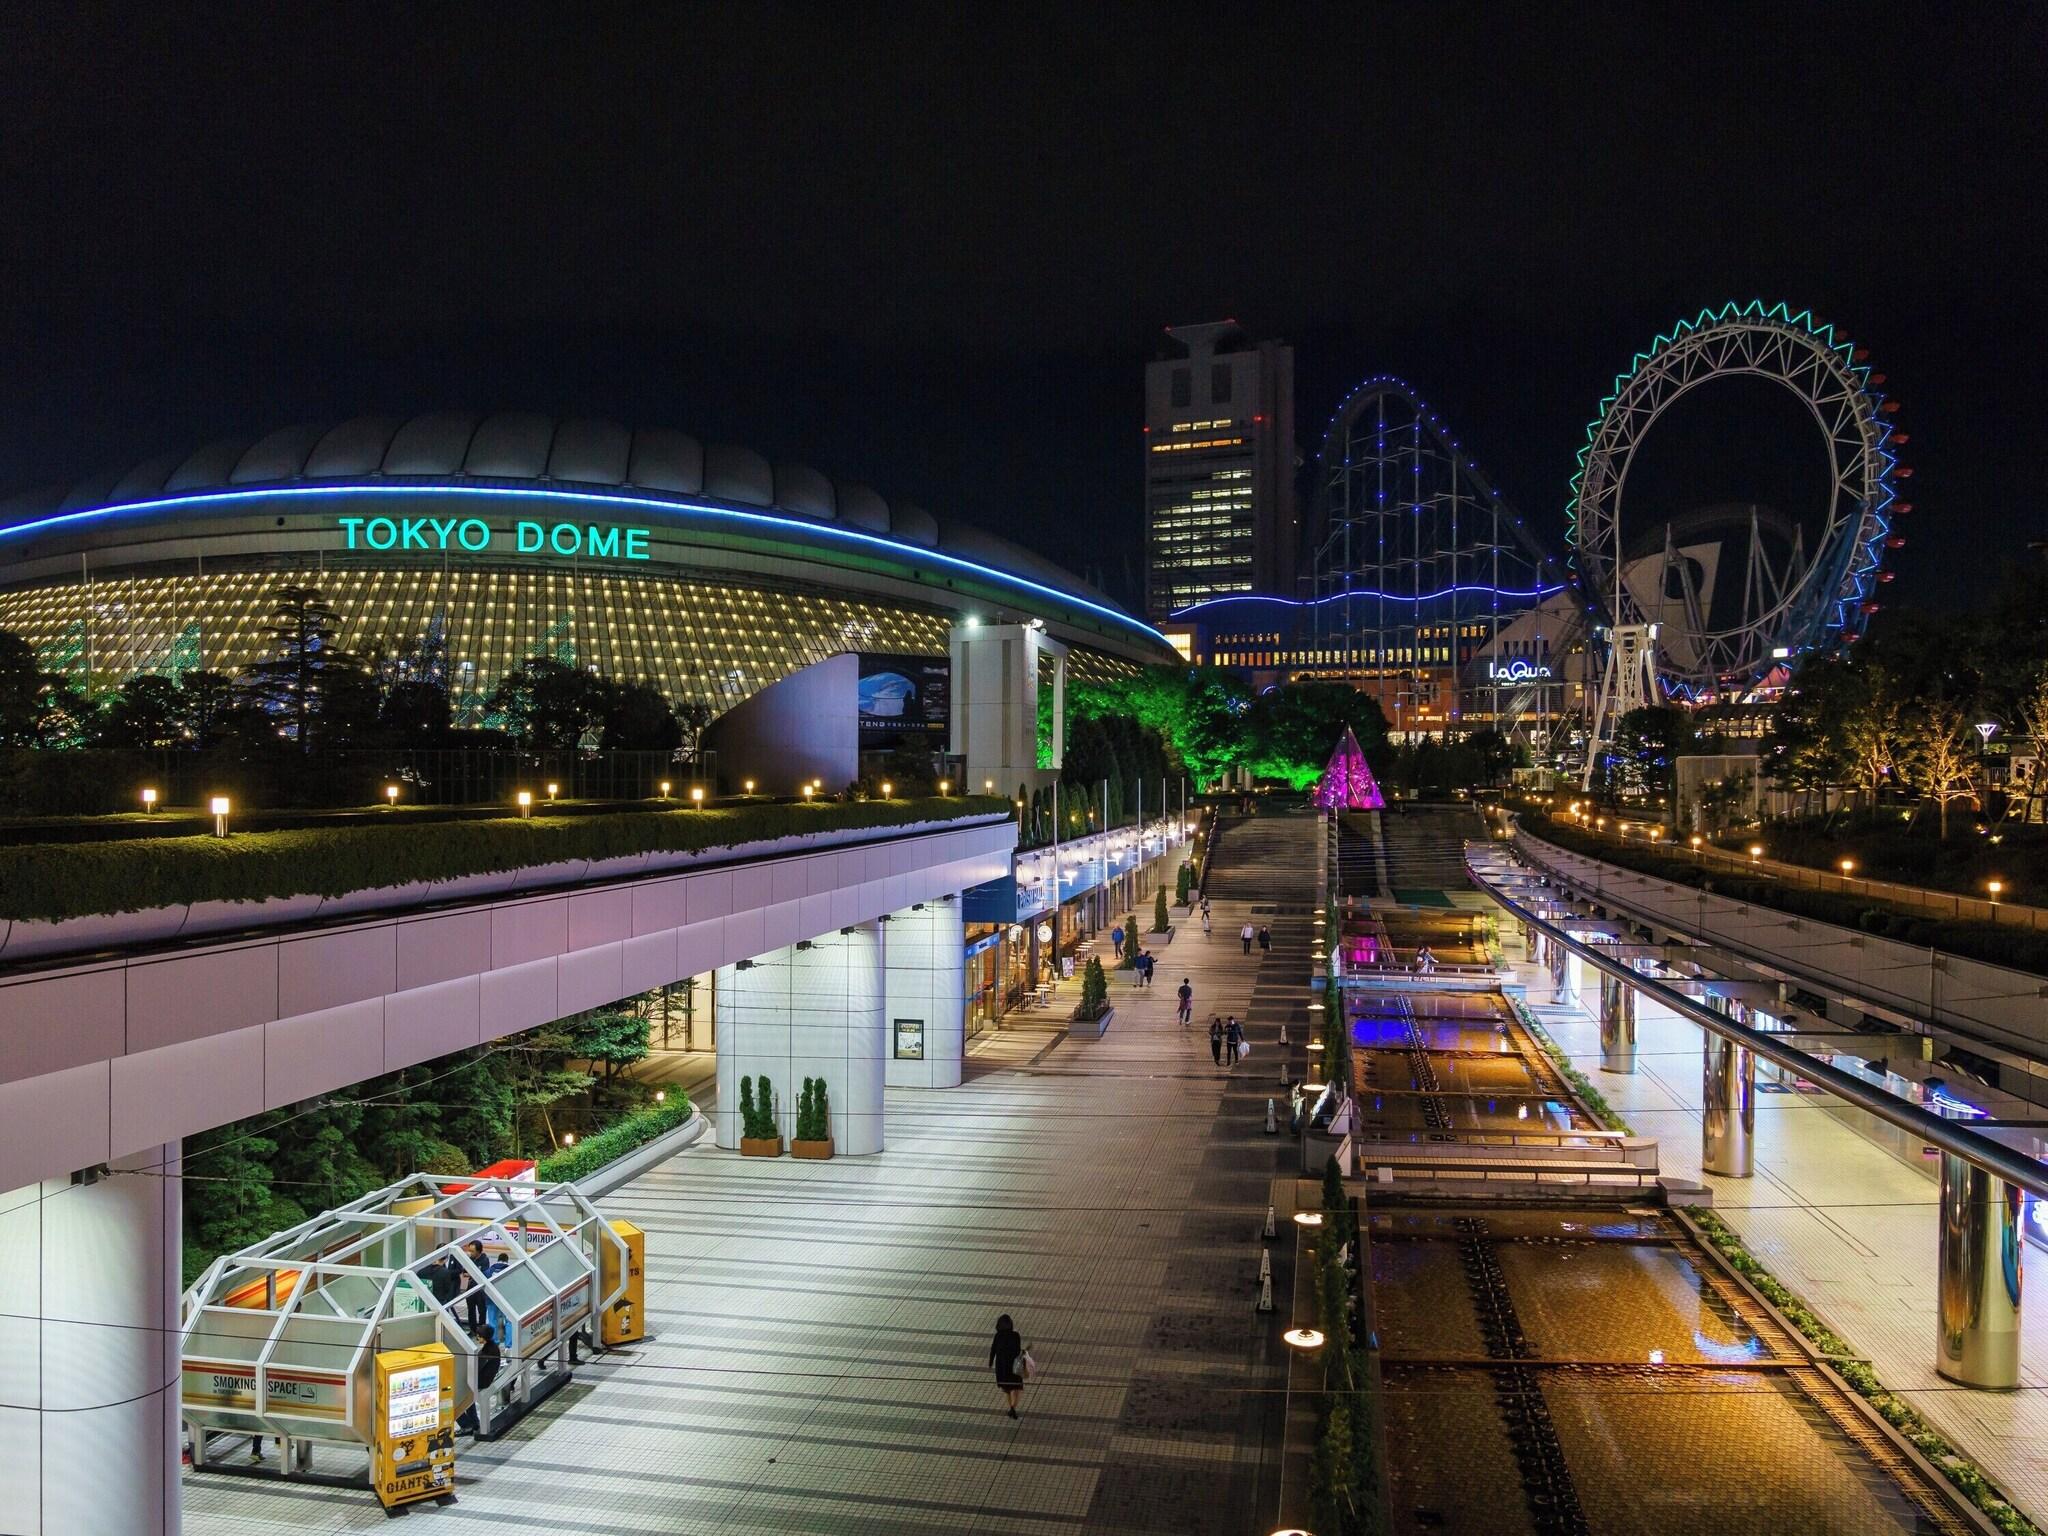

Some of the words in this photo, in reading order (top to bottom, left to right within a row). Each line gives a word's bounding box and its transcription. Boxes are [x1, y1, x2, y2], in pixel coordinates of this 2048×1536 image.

[338, 518, 491, 551] TOKYO
[517, 521, 650, 560] DOME
[213, 1375, 256, 1390] SMOKING
[268, 1380, 297, 1395] SPACE
[386, 1473, 430, 1494] GIANTS
